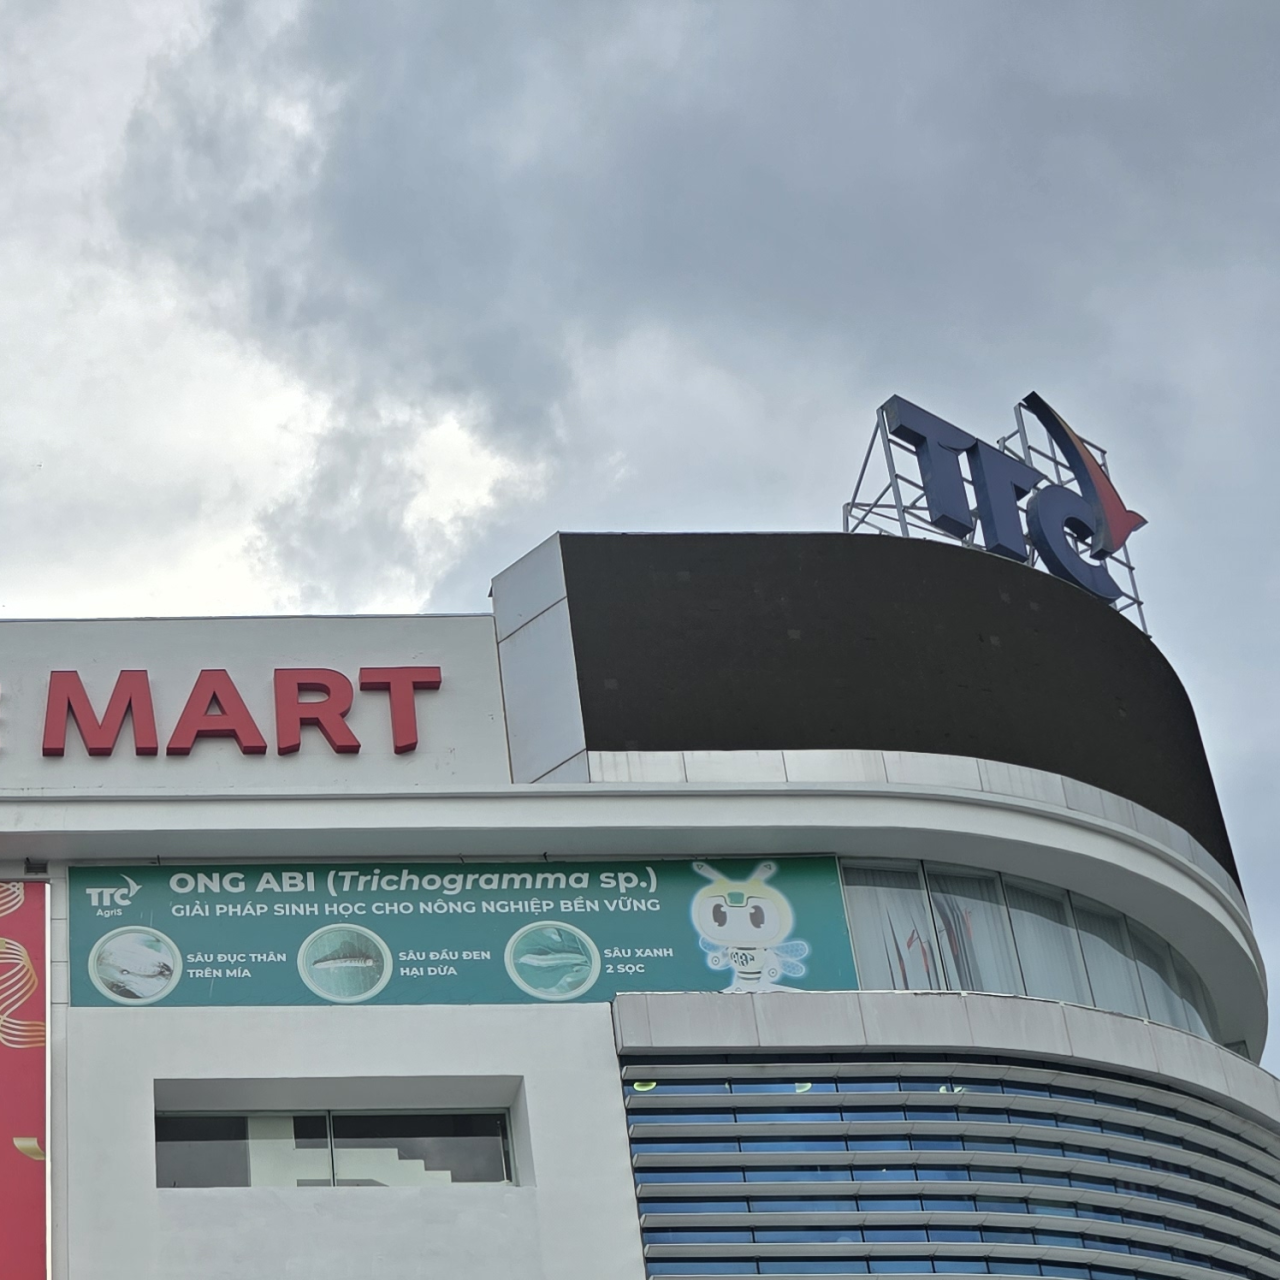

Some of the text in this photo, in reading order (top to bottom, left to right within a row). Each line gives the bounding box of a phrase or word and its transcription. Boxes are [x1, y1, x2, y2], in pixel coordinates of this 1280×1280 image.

[884, 392, 1130, 600] TTC
[42, 666, 442, 757] MART
[170, 866, 657, 896] ONG ABI (Trichogramma sp.)
[86, 884, 134, 906] TTC
[96, 908, 122, 918] AgriS
[171, 895, 660, 918] GIẢI PHÁP SINH HỌC CHO NÔNG NGHIỆP BỀN VỮNG
[186, 951, 287, 965] SÂU ĐỤC THÂN
[398, 950, 426, 961] SÂU
[462, 951, 491, 960] ĐEN
[603, 947, 673, 958] SÂU XANH
[186, 967, 251, 979] TRÊN MÍA
[400, 965, 458, 978] HẠI DỪA
[606, 963, 645, 975] 2 SỌC
